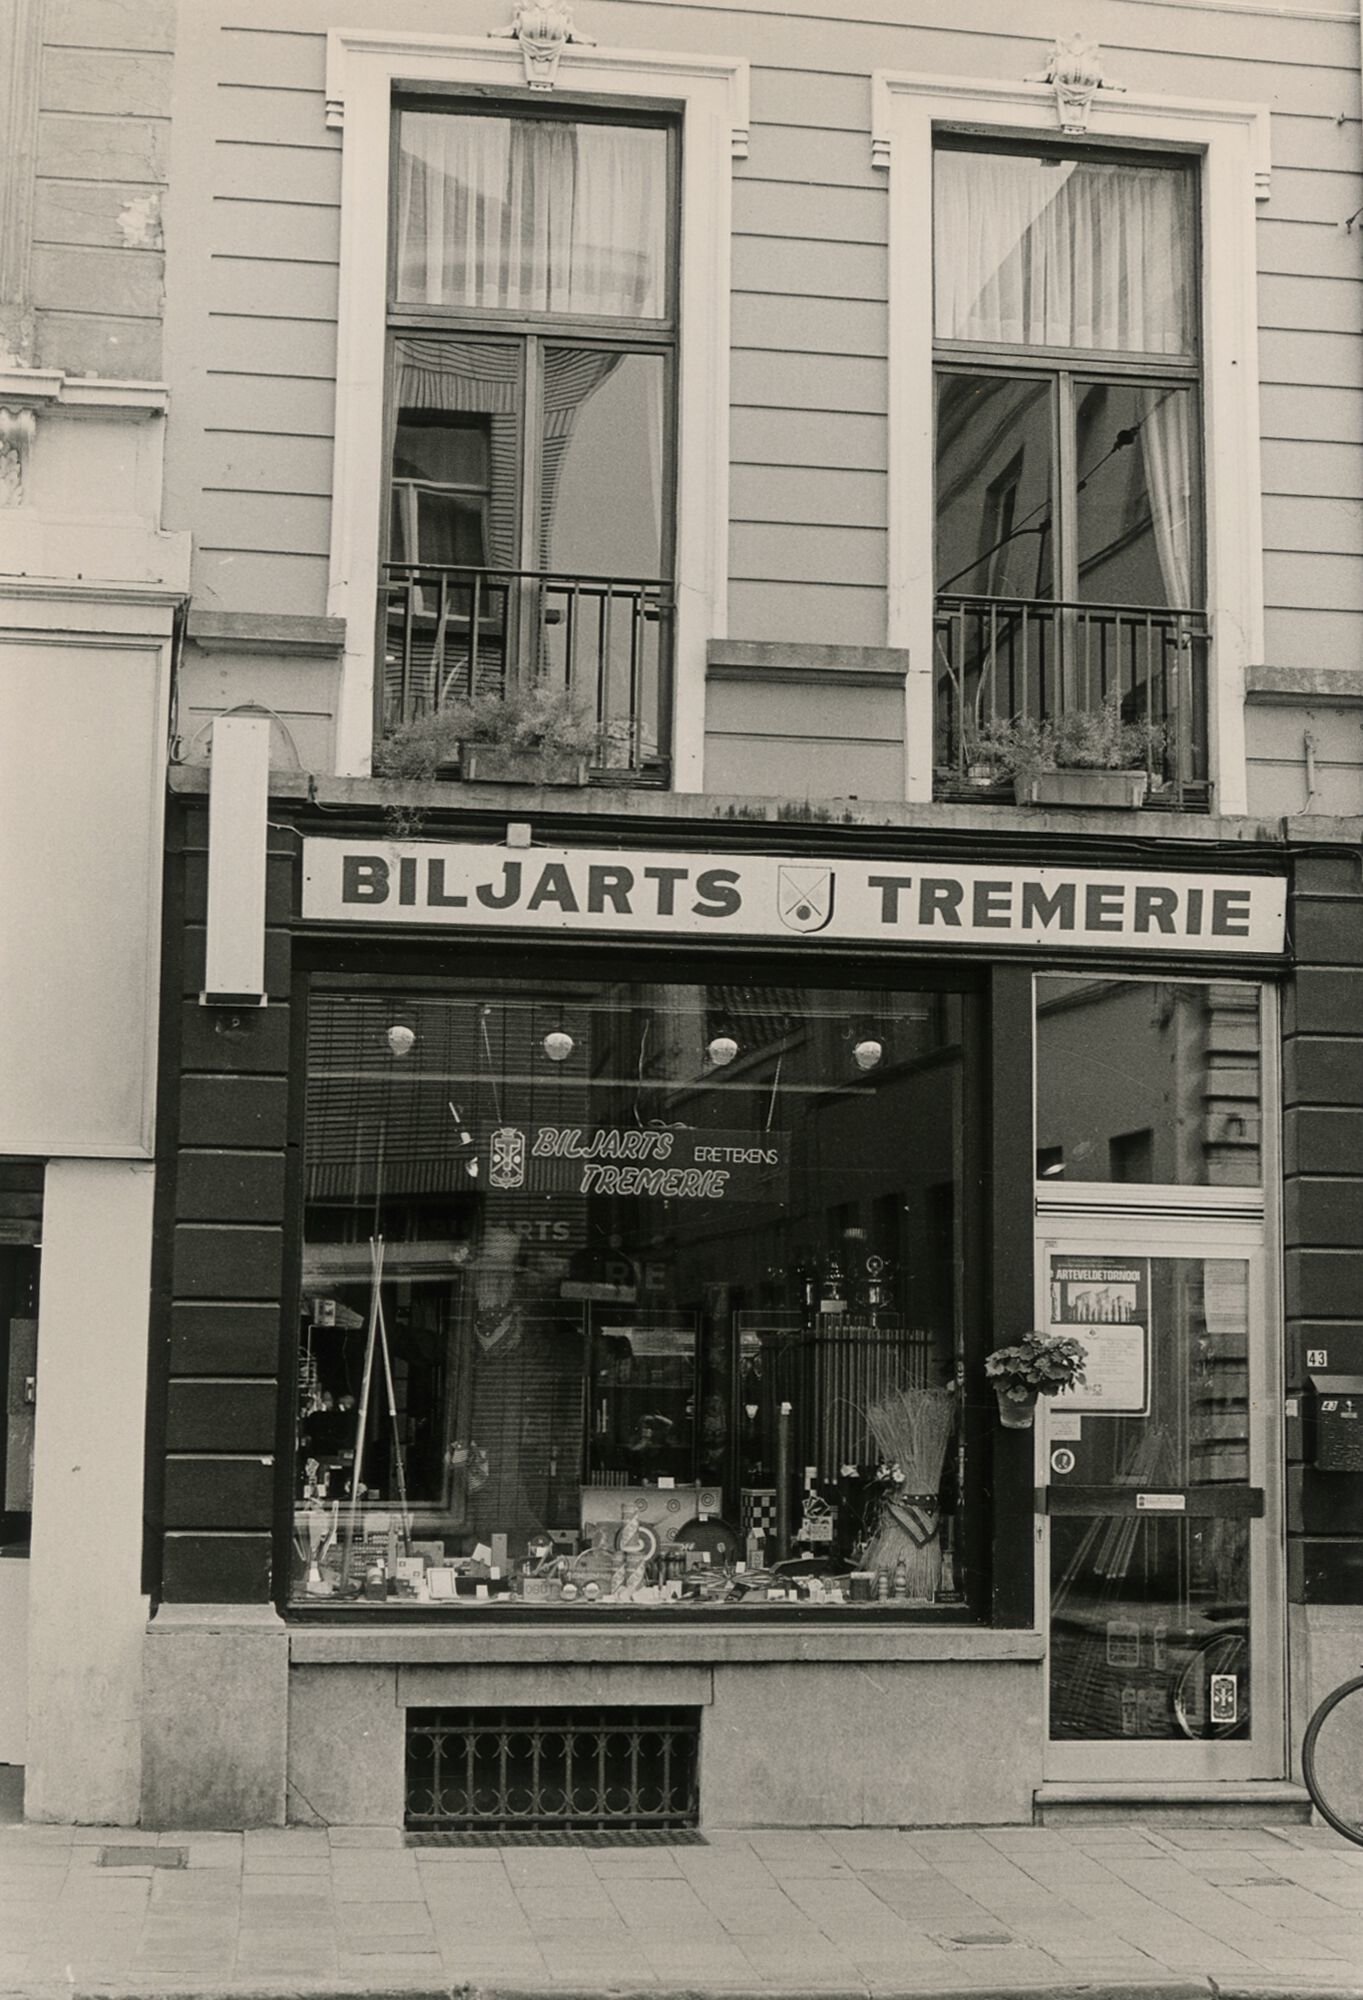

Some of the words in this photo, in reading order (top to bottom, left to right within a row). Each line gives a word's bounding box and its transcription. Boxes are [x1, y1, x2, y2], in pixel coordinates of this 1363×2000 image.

[342, 855, 742, 918] BILJARTS
[868, 875, 1251, 937] TREMERIE
[532, 1127, 674, 1160] BILJARTS
[694, 1146, 778, 1165] ERETEKENS
[580, 1164, 730, 1198] TREMERIE
[1309, 1351, 1325, 1366] 43
